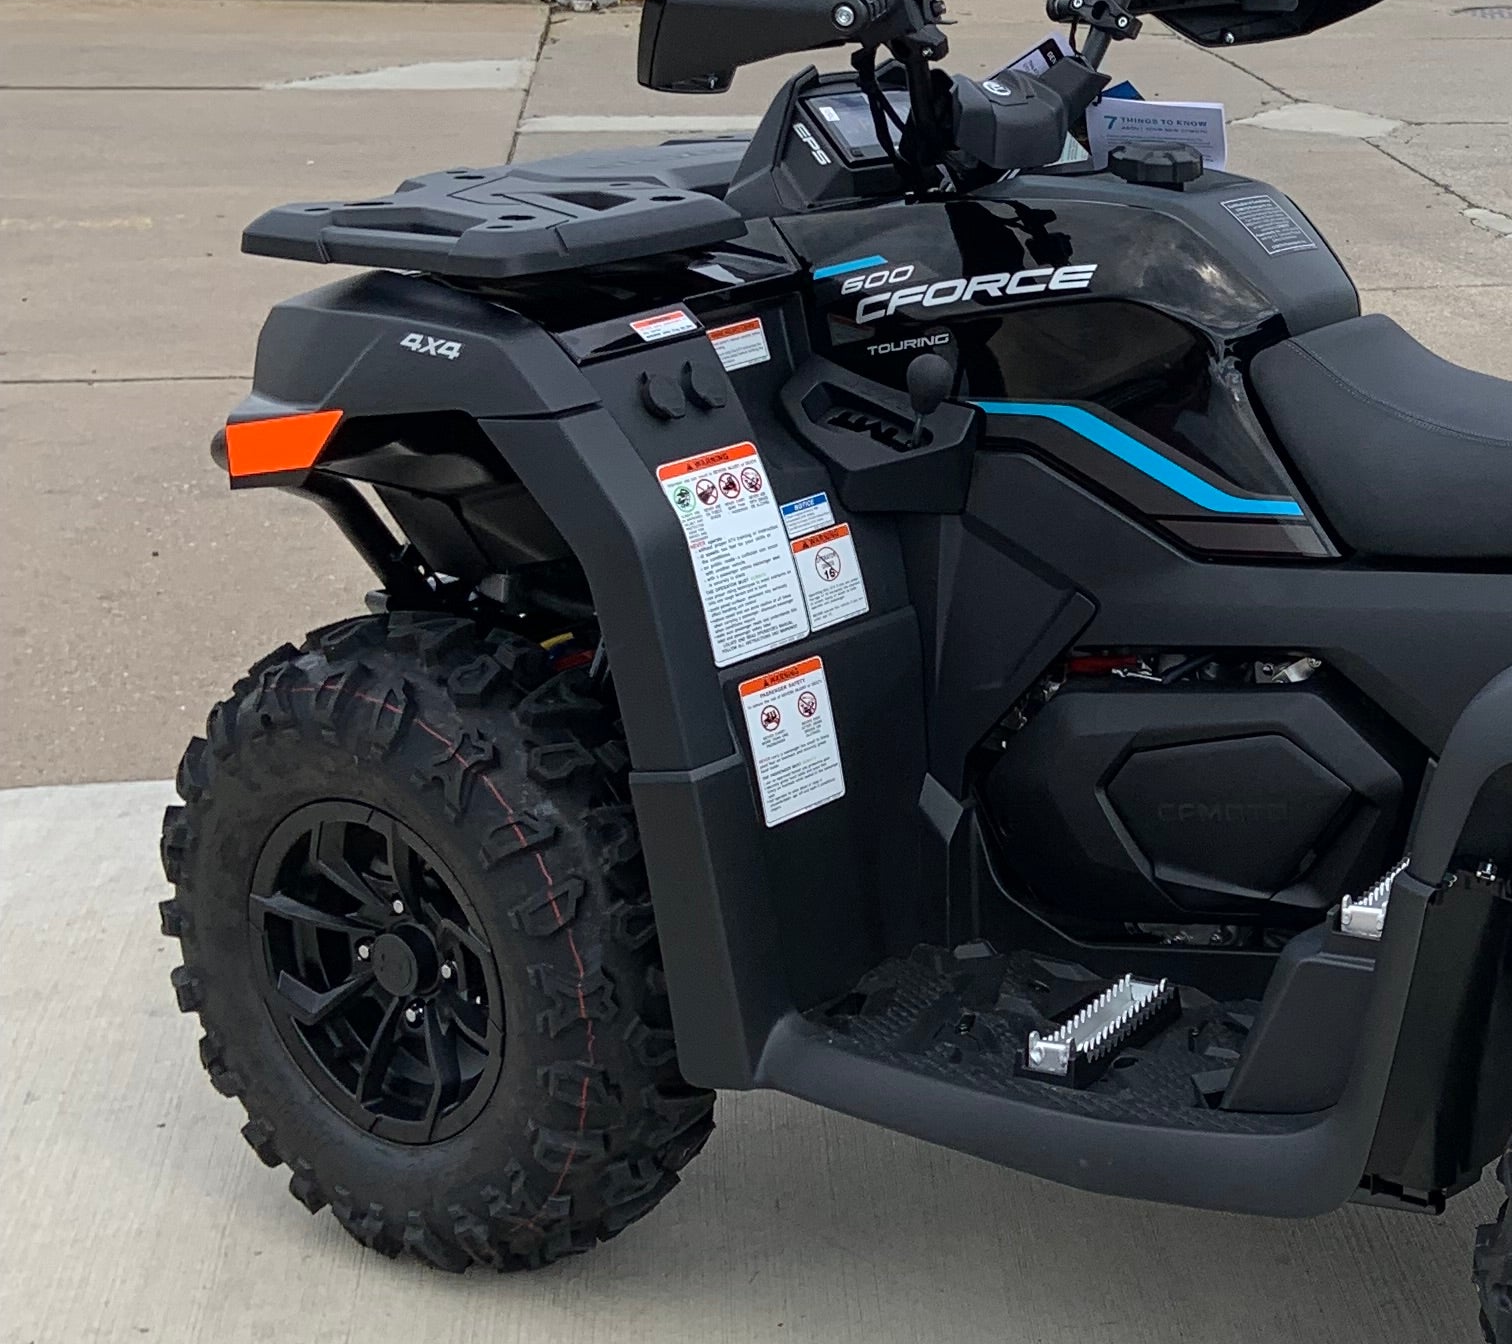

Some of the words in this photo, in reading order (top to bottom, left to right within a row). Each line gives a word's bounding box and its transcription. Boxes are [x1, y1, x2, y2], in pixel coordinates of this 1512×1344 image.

[1103, 115, 1118, 130] 7
[1120, 116, 1159, 125] THINGS
[1176, 119, 1208, 127] KNOW
[793, 122, 832, 166] EPS
[841, 264, 915, 295] 600
[855, 263, 1098, 325] CFORCE
[399, 332, 462, 360] 4X4
[866, 332, 950, 356] TOURING
[824, 569, 836, 580] 16
